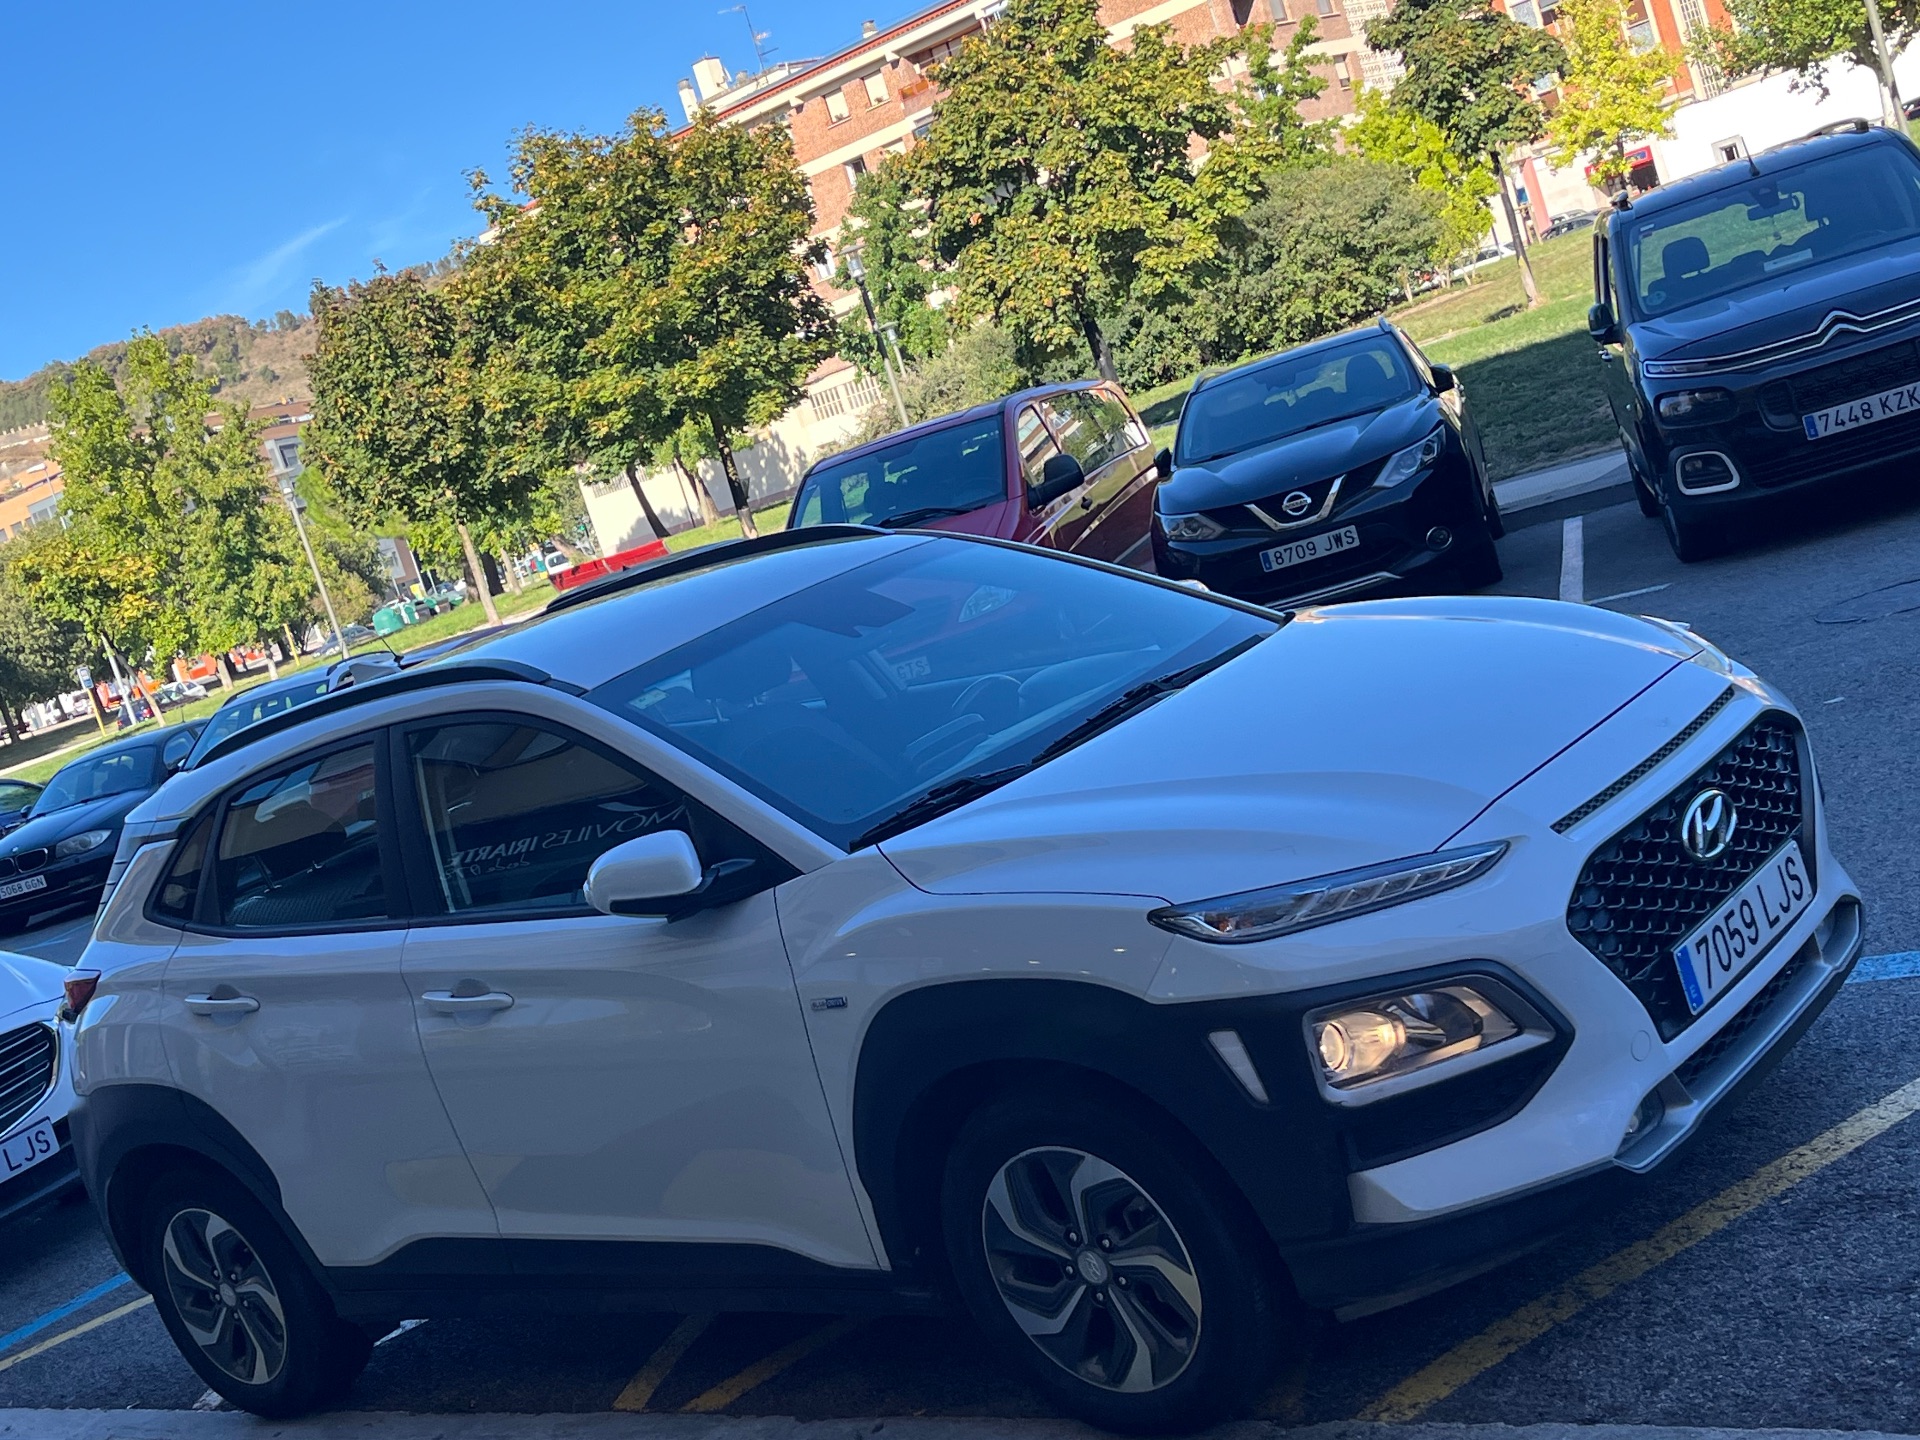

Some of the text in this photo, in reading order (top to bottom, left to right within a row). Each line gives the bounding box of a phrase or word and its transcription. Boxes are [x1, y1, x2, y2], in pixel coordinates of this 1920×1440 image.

[1818, 386, 1920, 432] 7448 KZK
[1274, 530, 1355, 566] 8709 JWS
[0, 876, 45, 897] 5068 GGN
[1695, 856, 1803, 989] 7059 LJS
[2, 1129, 51, 1172] LJS
